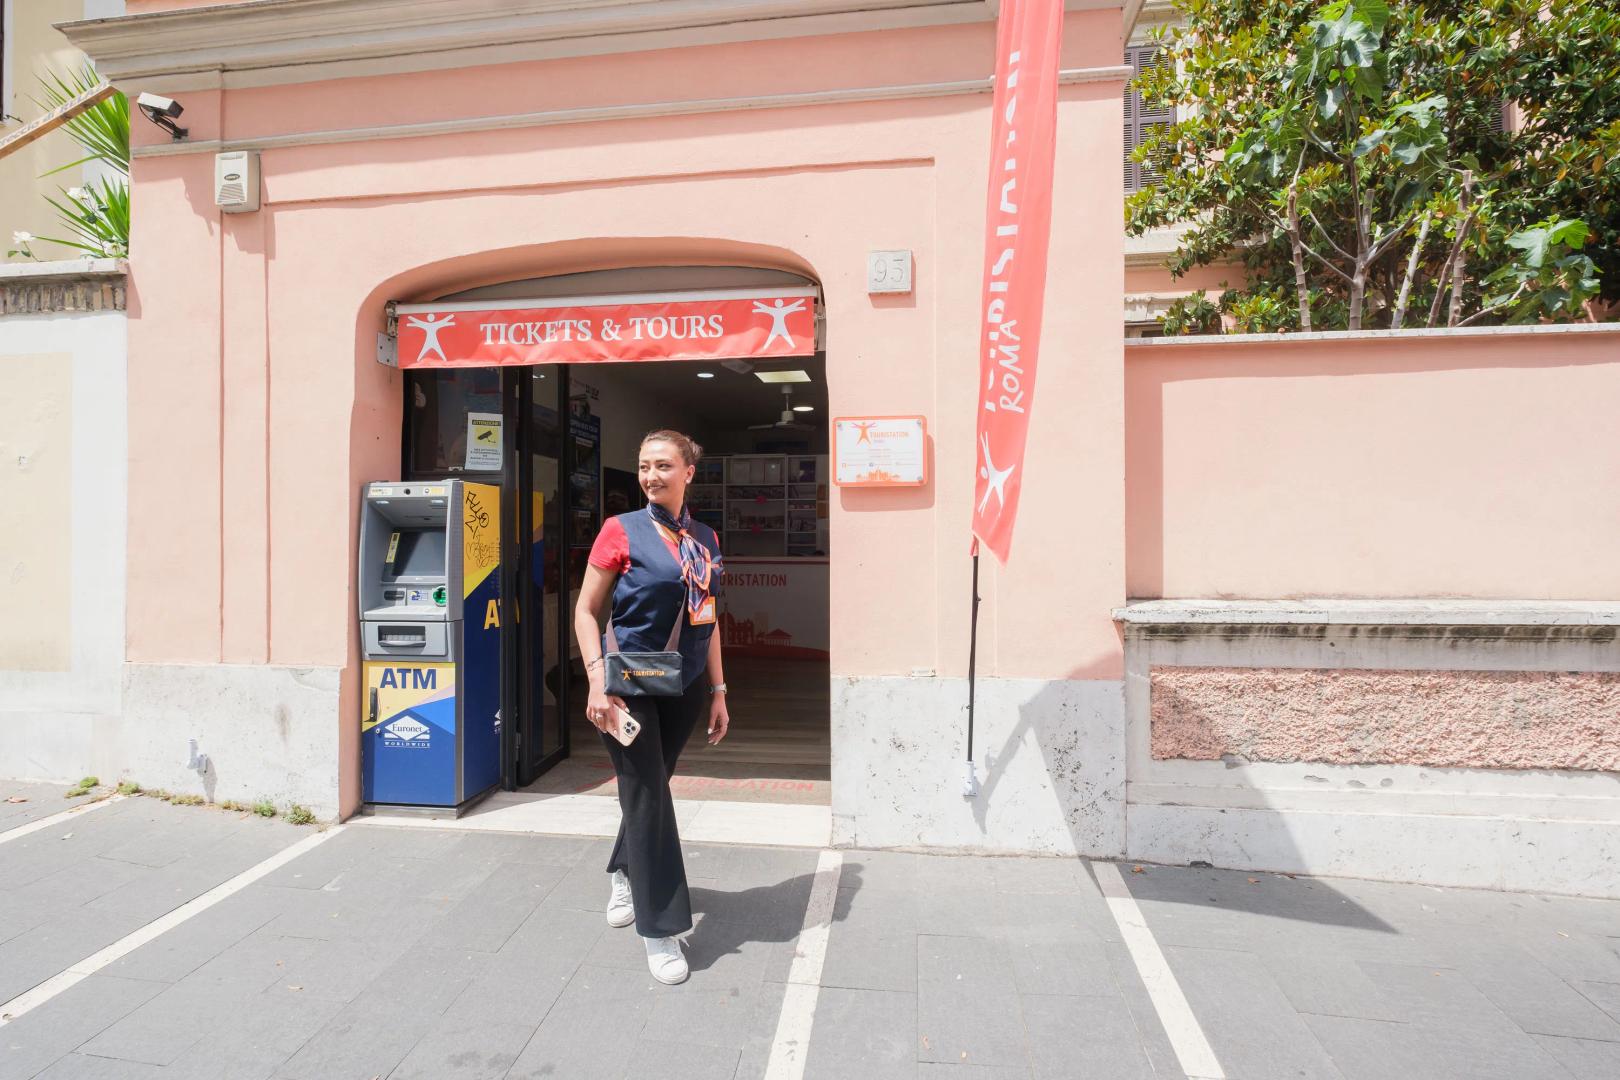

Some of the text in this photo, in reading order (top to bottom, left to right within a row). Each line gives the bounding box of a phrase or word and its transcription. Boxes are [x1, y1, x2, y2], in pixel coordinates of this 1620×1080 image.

[480, 314, 724, 345] TICKETS & TOURS
[999, 319, 1024, 413] ROMA
[720, 573, 787, 587] URISTATION
[380, 668, 437, 690] ATM
[392, 724, 422, 733] Euronet
